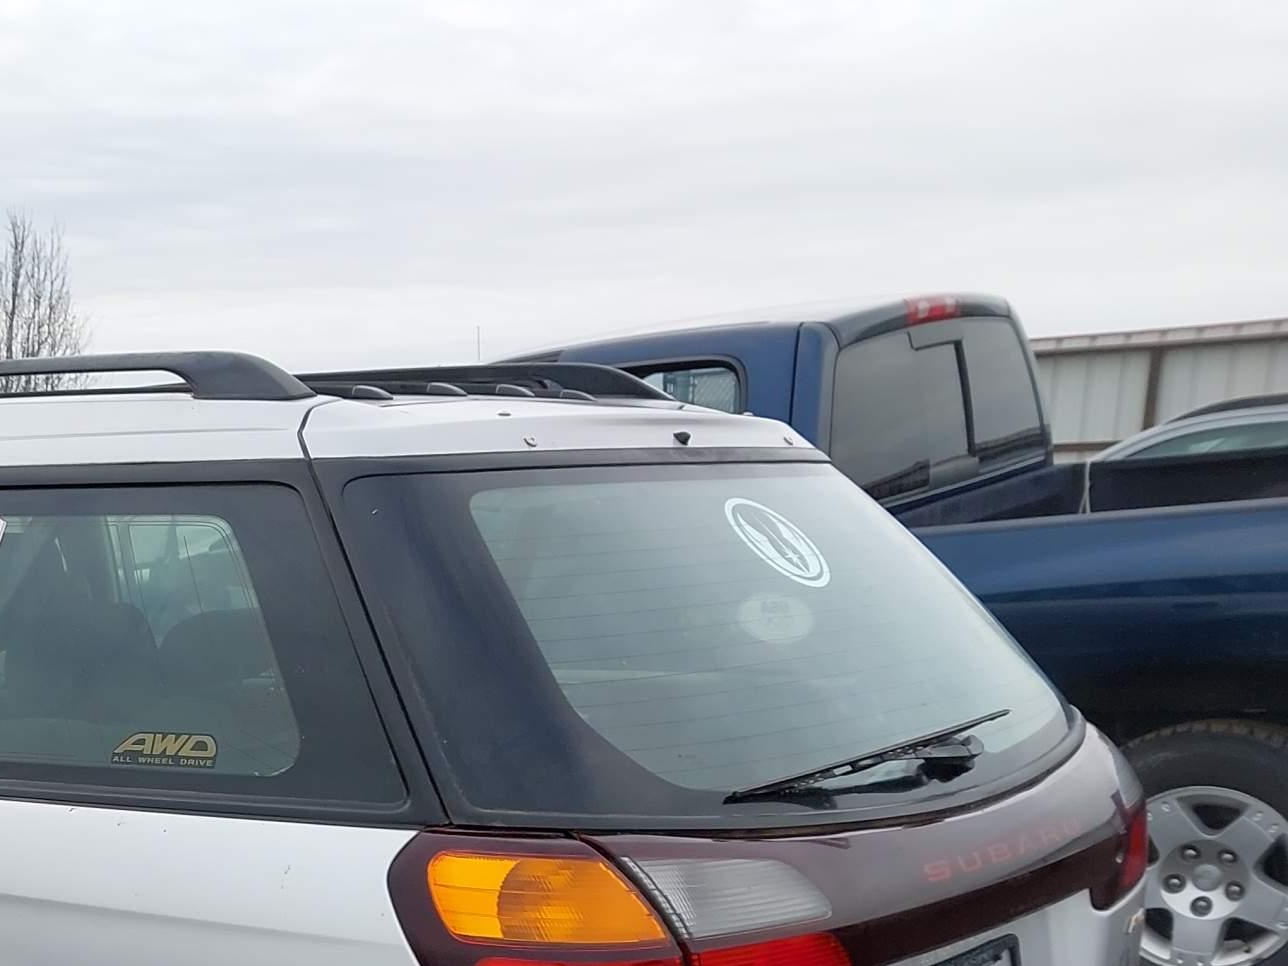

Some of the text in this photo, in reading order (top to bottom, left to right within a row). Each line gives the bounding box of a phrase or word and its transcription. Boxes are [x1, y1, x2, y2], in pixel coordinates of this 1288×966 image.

[113, 732, 217, 758] AWD
[112, 755, 214, 767] ALL WHEEL DRIVE
[923, 815, 1083, 882] SUBARU
